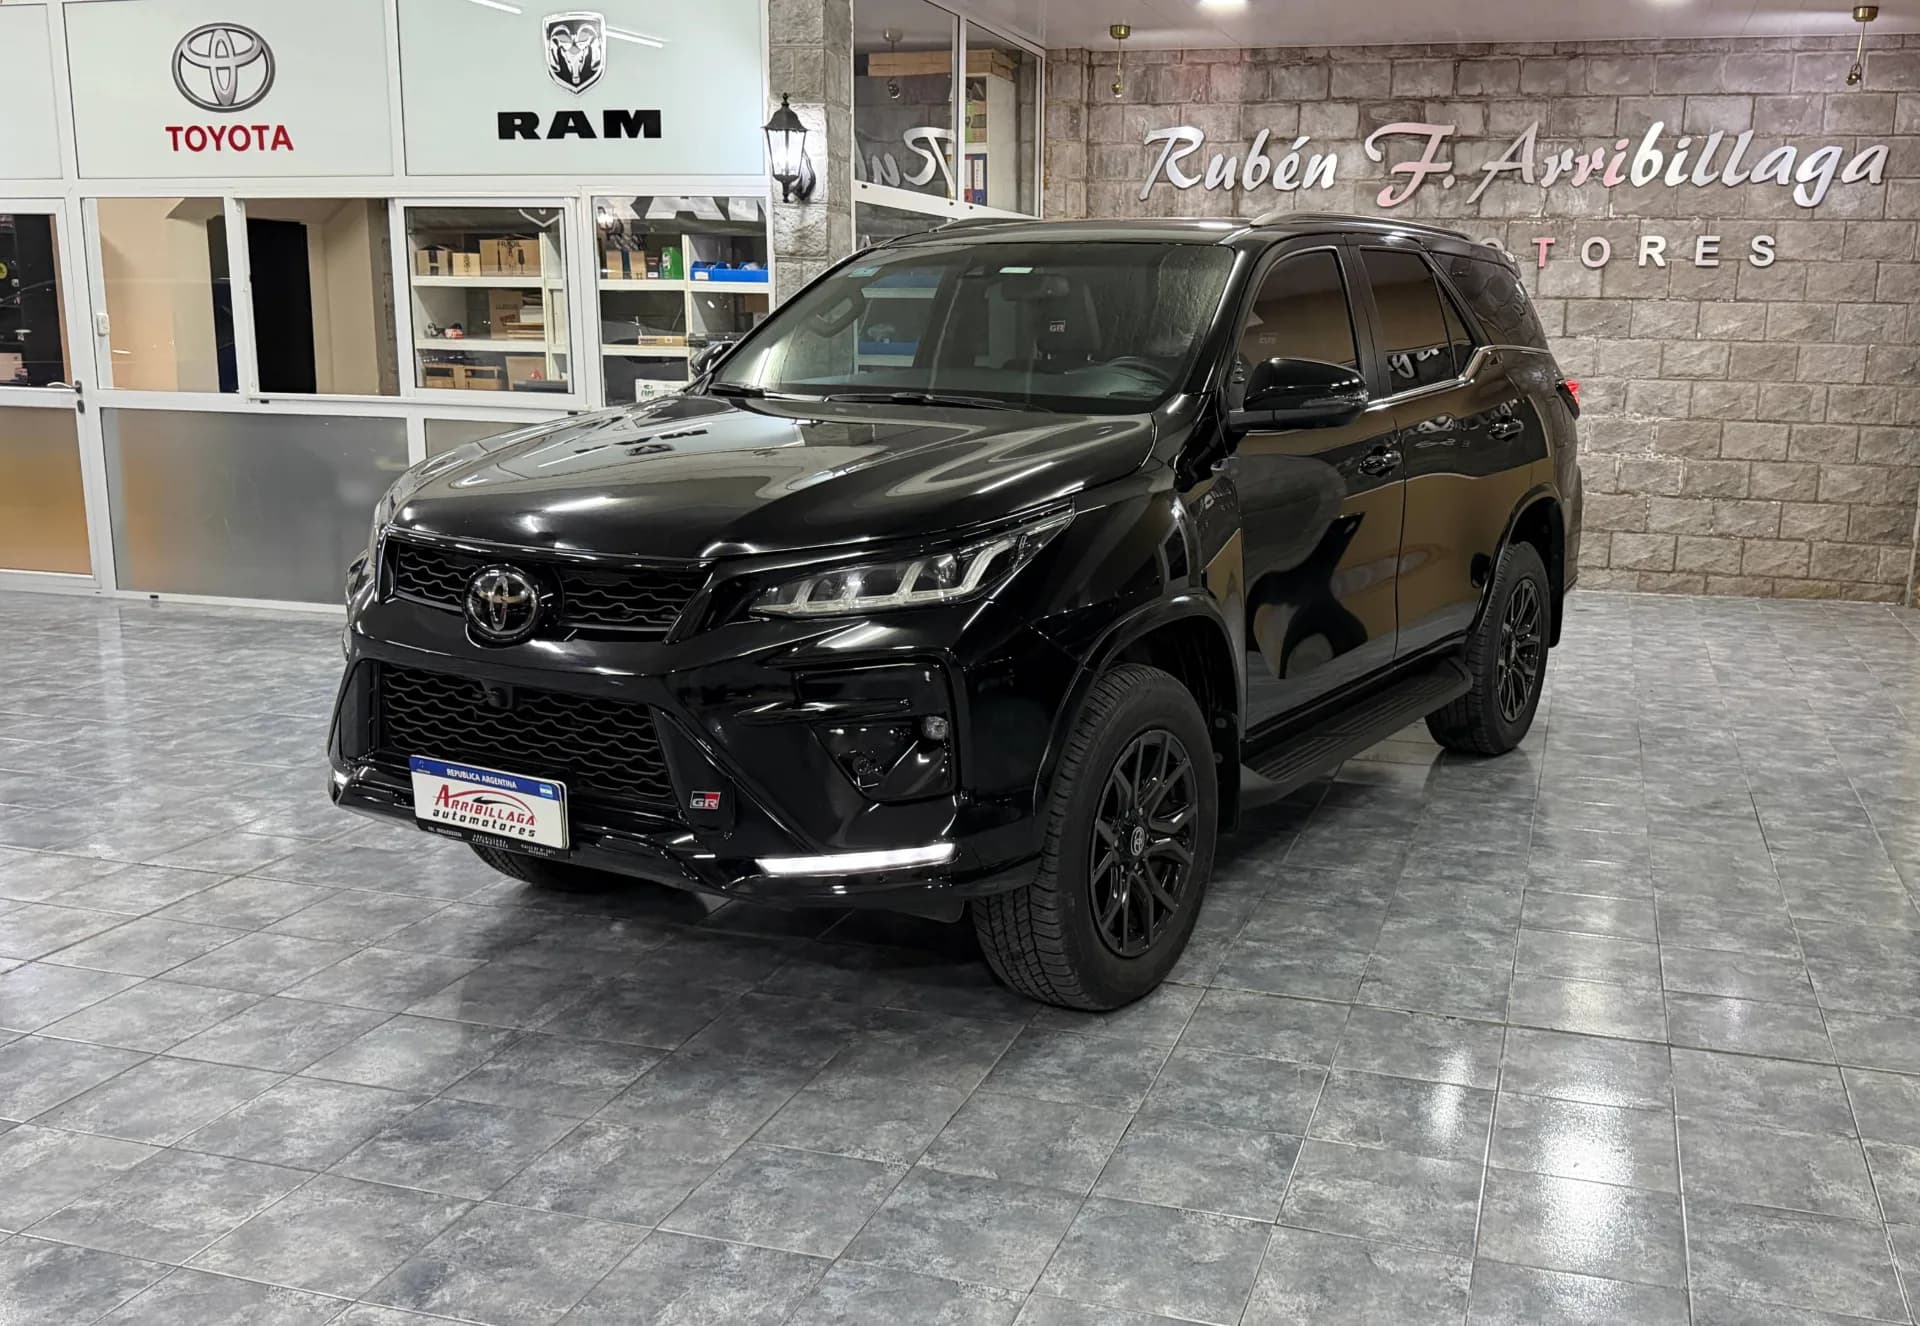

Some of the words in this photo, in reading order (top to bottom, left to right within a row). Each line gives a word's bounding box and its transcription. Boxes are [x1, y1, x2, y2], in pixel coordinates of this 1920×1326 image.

[165, 125, 294, 152] TOYOTA
[497, 109, 662, 140] RAM
[1138, 126, 1338, 202] Rubén
[1467, 120, 1890, 208] Arribillaga
[481, 771, 518, 789] ARGENTINA
[434, 784, 537, 826] ARRIBILLAGA
[691, 797, 719, 808] GR
[432, 808, 537, 838] automotores
